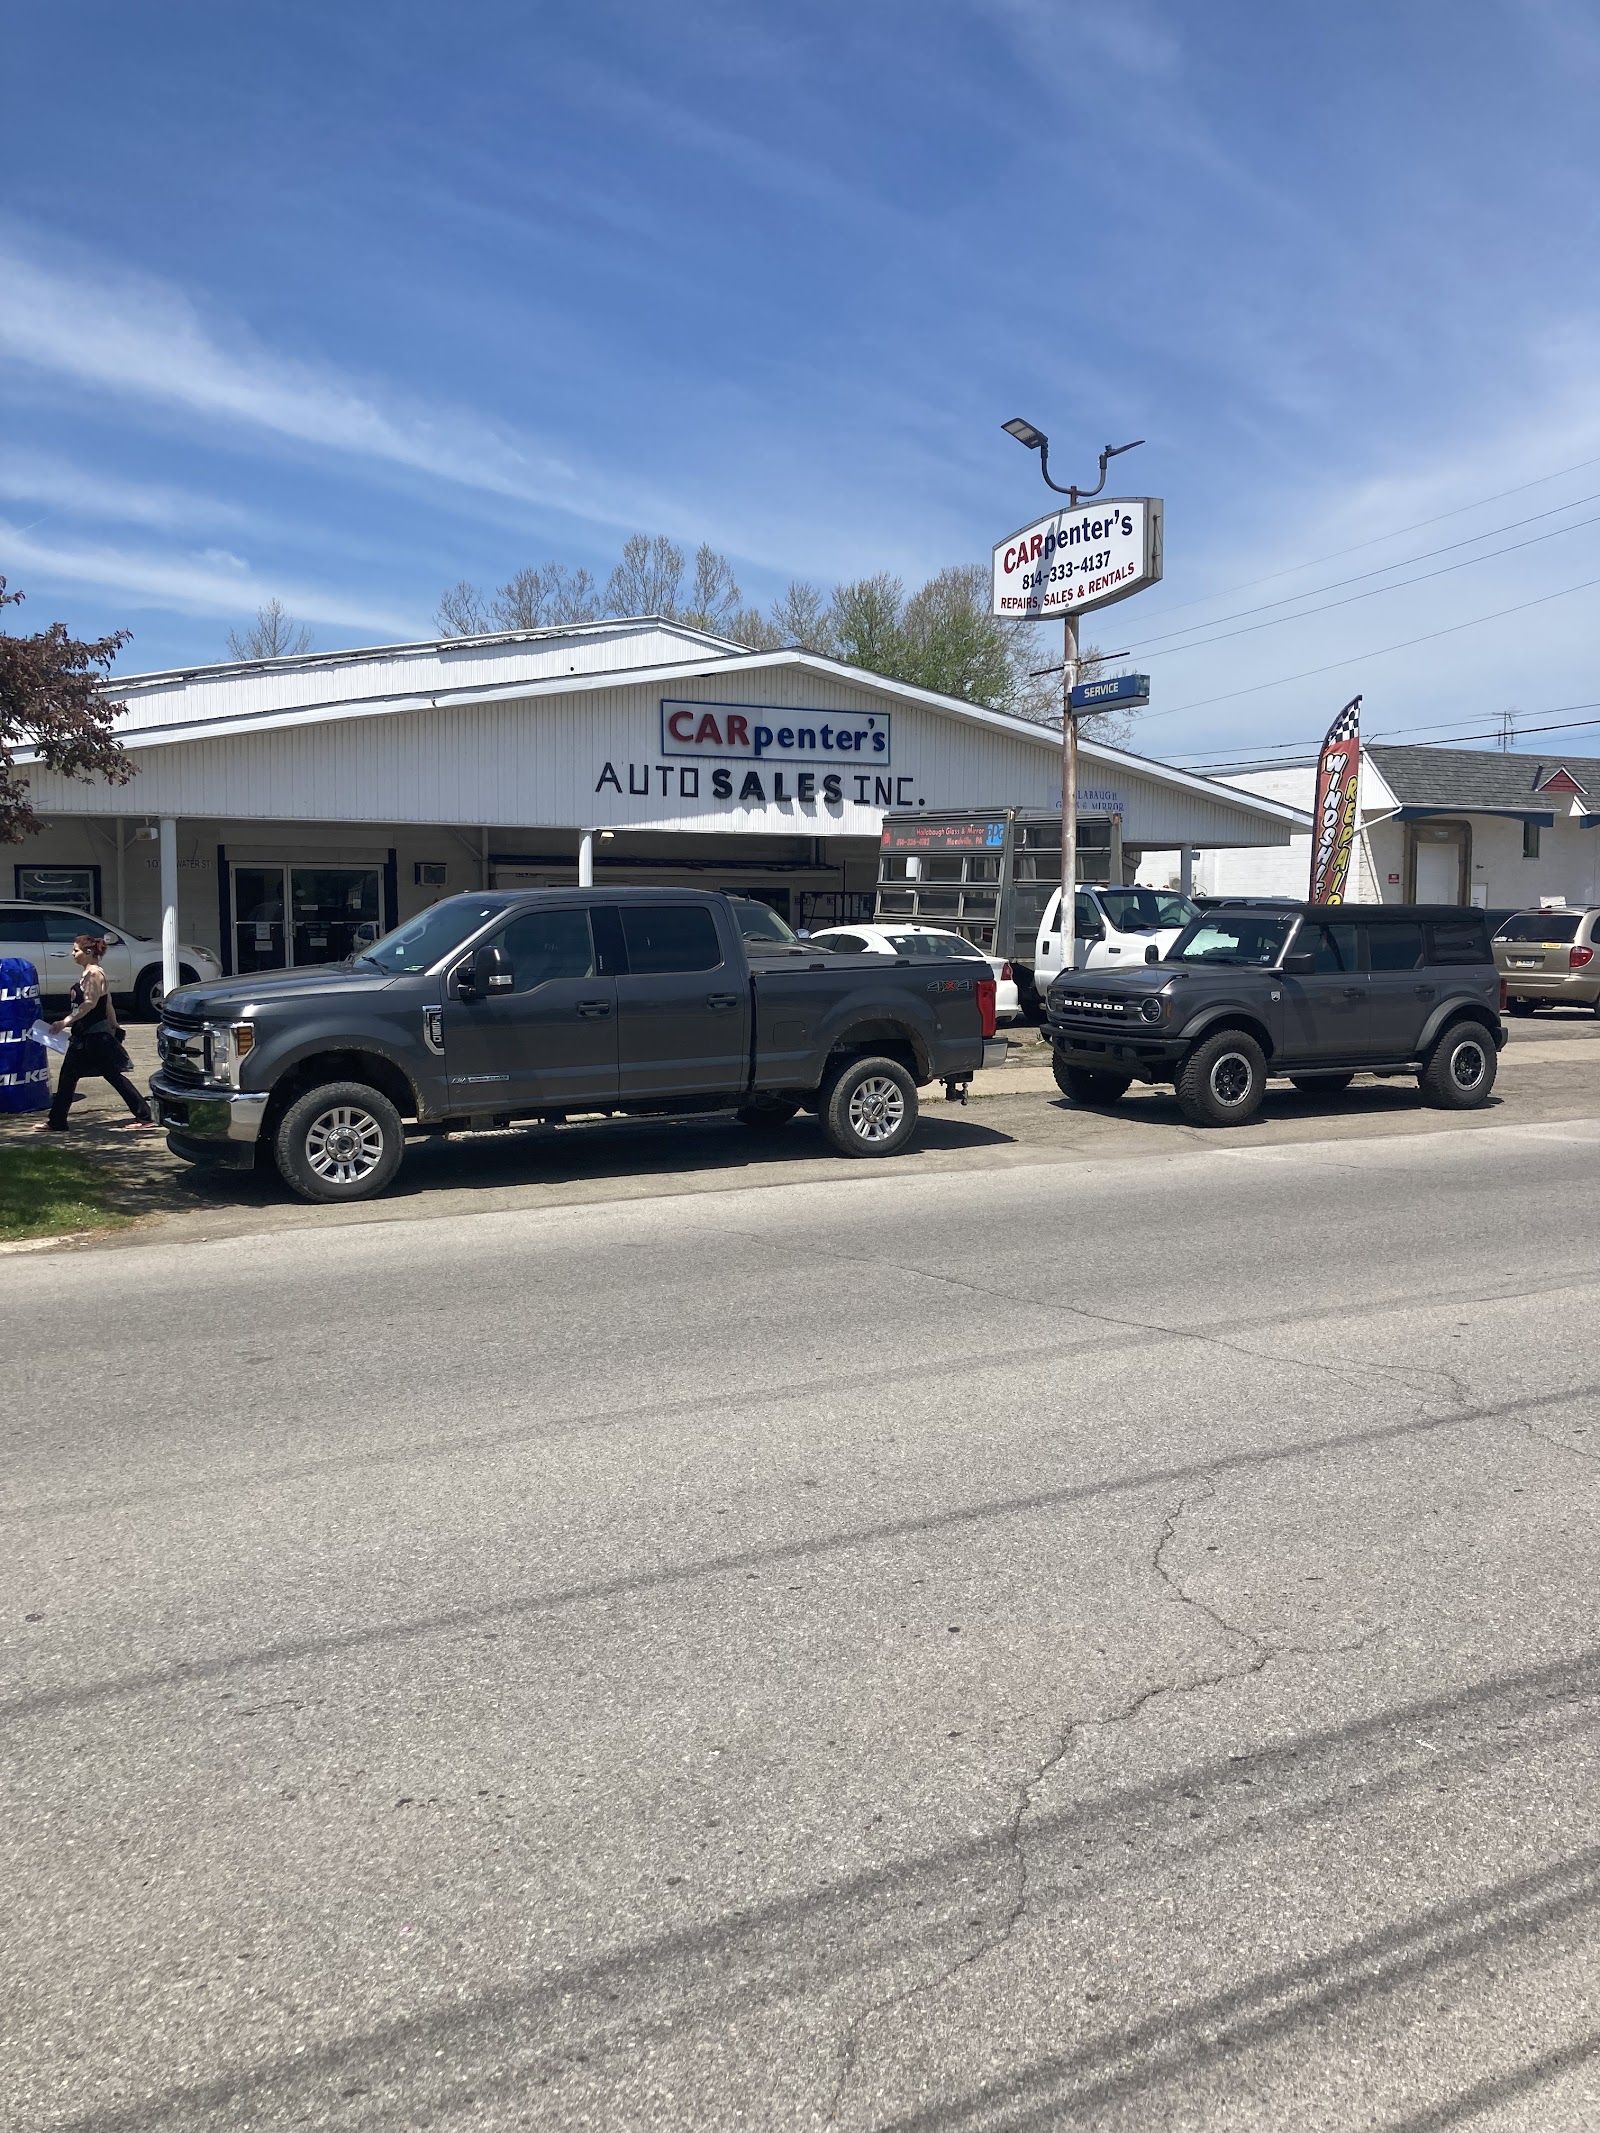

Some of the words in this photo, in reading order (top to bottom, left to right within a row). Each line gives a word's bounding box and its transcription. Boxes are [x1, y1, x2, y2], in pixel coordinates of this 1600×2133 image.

[1003, 509, 1133, 575] CARpenter's
[1001, 597, 1040, 612] REPAIRS,
[1043, 588, 1074, 606] SALES
[1077, 584, 1085, 598] &
[1088, 561, 1135, 594] RENTALS
[1022, 550, 1111, 590] 814-333-4137
[1084, 682, 1119, 698] SERVICE
[668, 710, 886, 755] CARpenter's
[595, 762, 699, 798] AUTO
[711, 768, 844, 805] SALES
[853, 775, 926, 806] INC.
[945, 826, 960, 836] Glass
[1064, 1000, 1124, 1010] BRONCO
